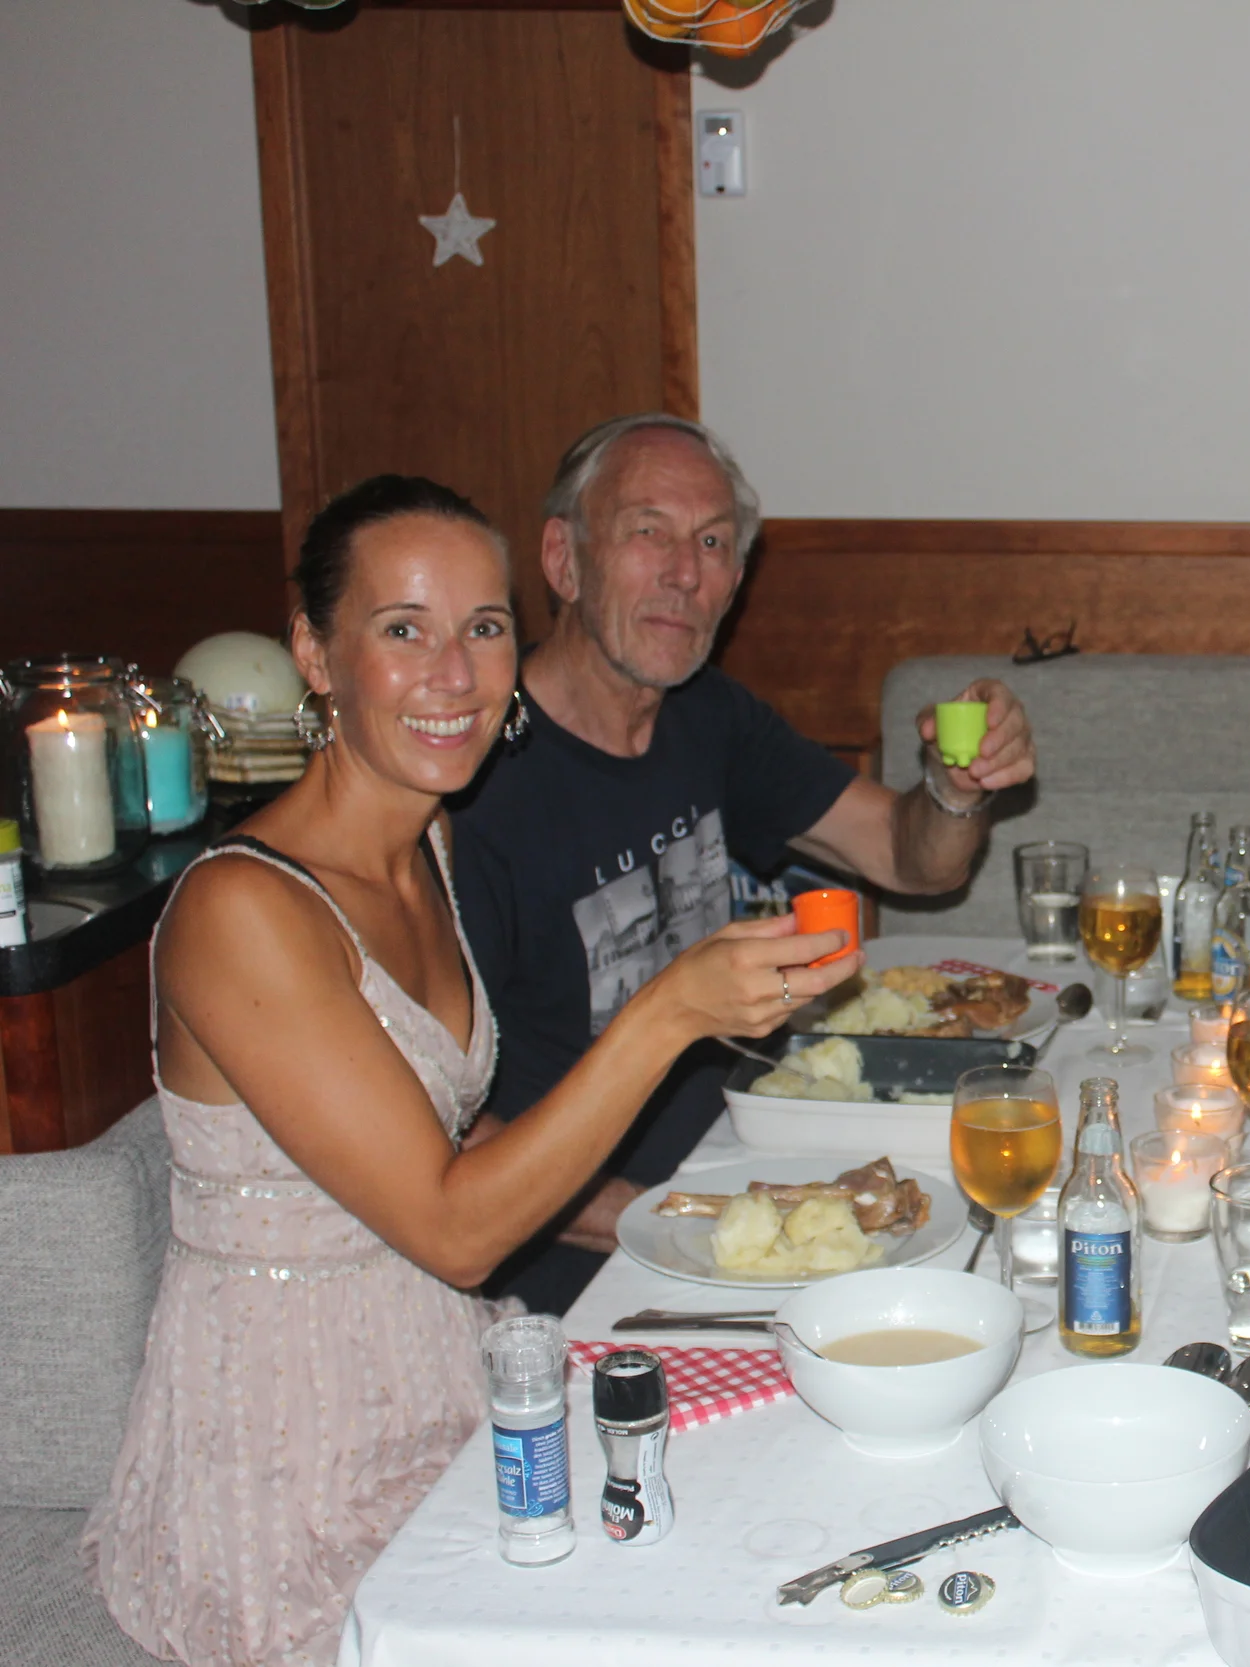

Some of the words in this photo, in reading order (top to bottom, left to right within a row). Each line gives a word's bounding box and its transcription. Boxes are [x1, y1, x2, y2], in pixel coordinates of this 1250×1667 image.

[1071, 1240, 1123, 1255] Piton
[602, 1498, 635, 1521] Molin
[955, 1574, 967, 1605] Piton
